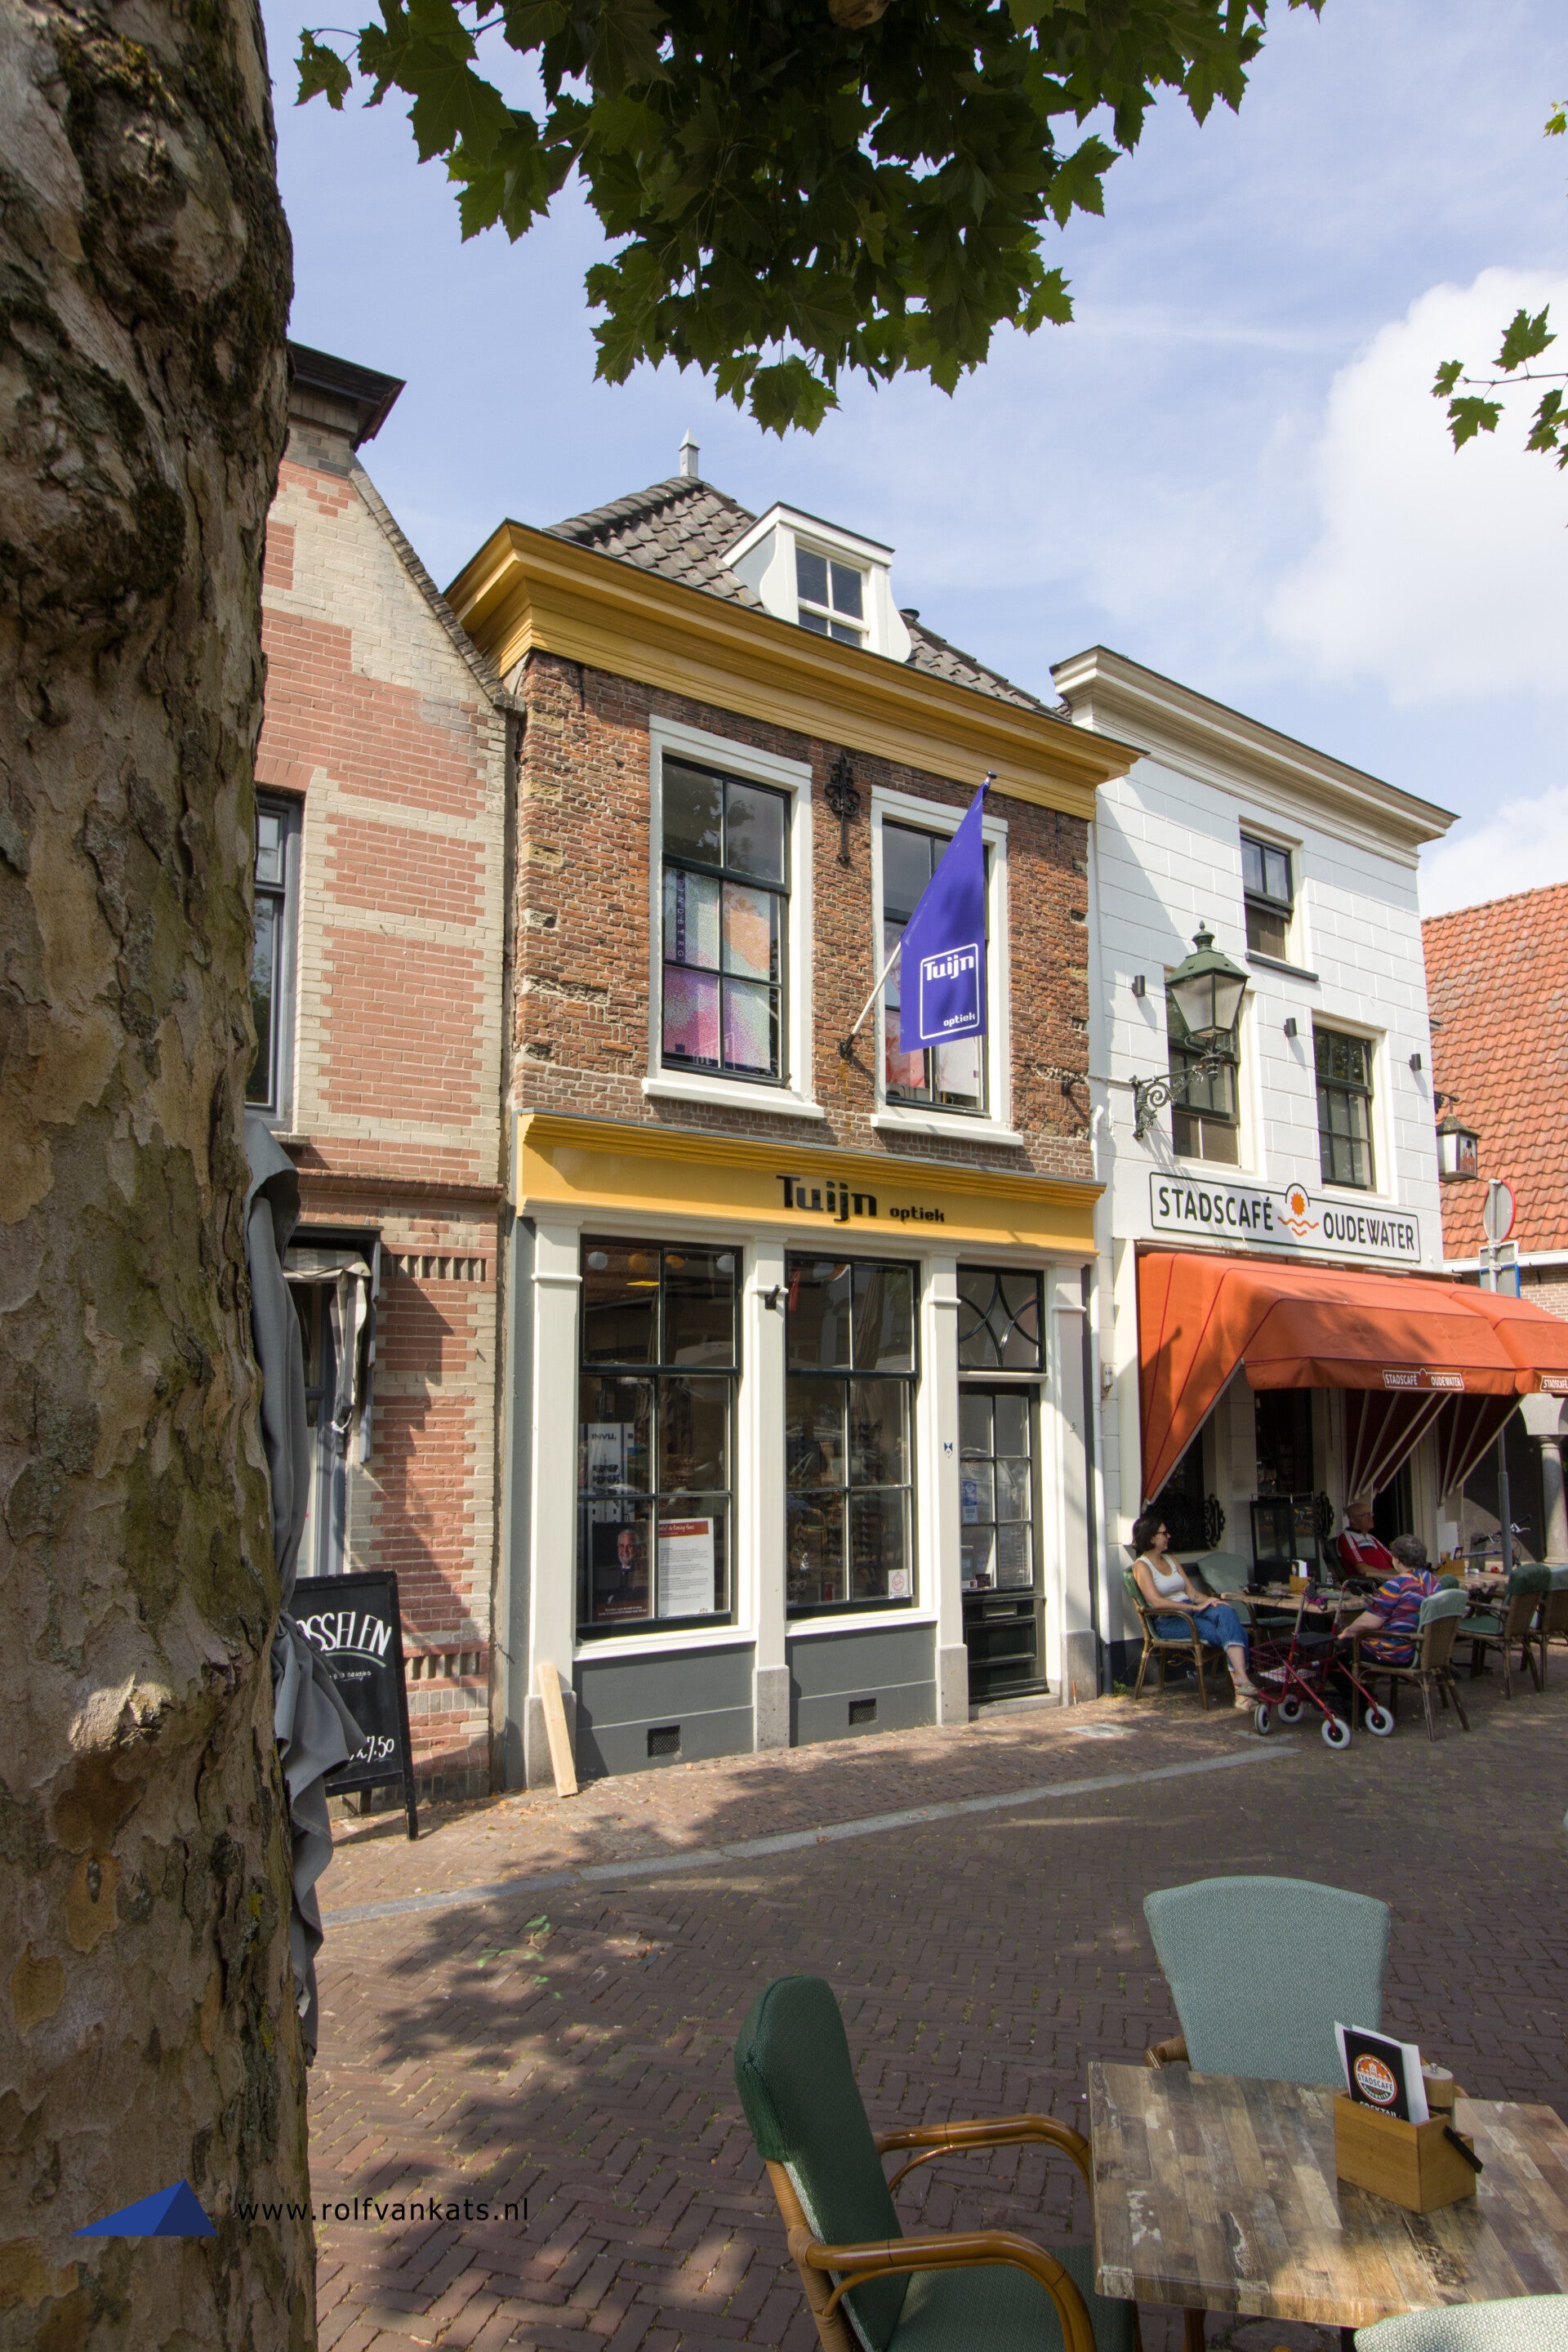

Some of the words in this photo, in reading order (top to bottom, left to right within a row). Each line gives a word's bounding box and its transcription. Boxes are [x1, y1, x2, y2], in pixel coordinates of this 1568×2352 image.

[924, 955, 974, 981] Tuijn
[943, 1012, 976, 1027] optiek
[777, 1175, 877, 1222] Tuijn
[889, 1206, 945, 1223] optiek
[1159, 1187, 1274, 1232] STADSCAFÉ
[1323, 1212, 1415, 1251] OUDEWATER
[1385, 1374, 1419, 1386] STADSCAFÉ
[1431, 1376, 1462, 1387] OUDEWATER
